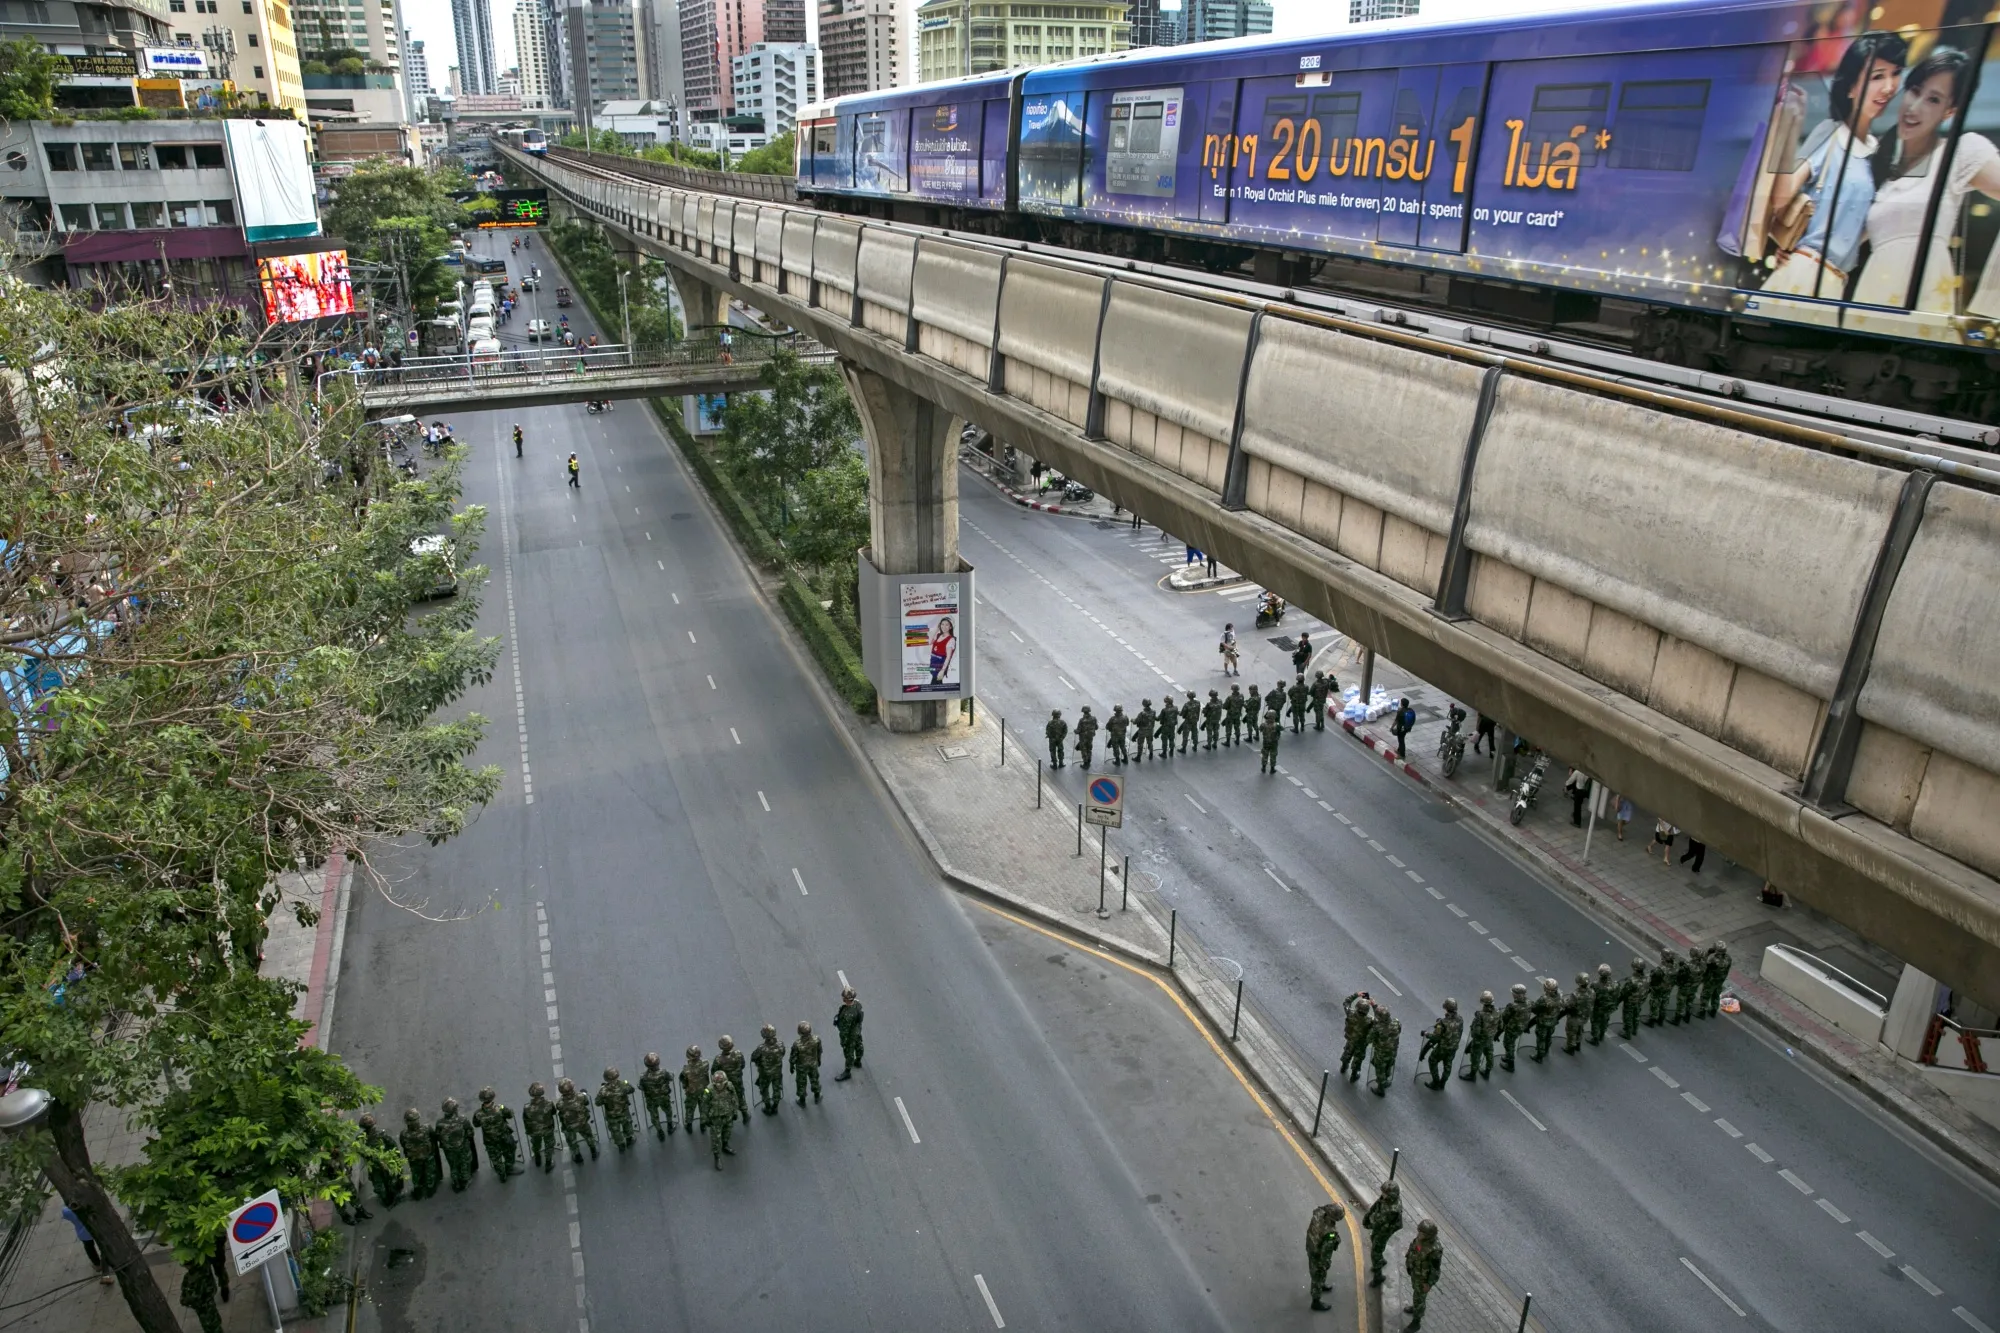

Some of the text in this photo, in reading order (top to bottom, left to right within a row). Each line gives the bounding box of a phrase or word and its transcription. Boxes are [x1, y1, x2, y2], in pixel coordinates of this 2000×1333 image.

[1301, 57, 1320, 67] 3209
[1203, 134, 1258, 179] ทุกๆ
[1267, 118, 1322, 182] 20
[1329, 125, 1435, 181] บาทรับ
[1450, 117, 1476, 193] 1
[1156, 175, 1173, 189] VISA
[1214, 185, 1236, 198] Earn
[1237, 187, 1241, 198] 1
[1244, 187, 1266, 203] Royal
[1268, 188, 1295, 203] Orchid
[1298, 190, 1316, 205] Plus
[1319, 192, 1337, 206] mile
[1340, 193, 1354, 208] for
[1355, 197, 1380, 214] every
[1383, 197, 1396, 212] 20
[1400, 198, 1426, 214] baht
[1430, 202, 1463, 219] spent
[1473, 207, 1489, 221] on
[1493, 209, 1522, 225] your
